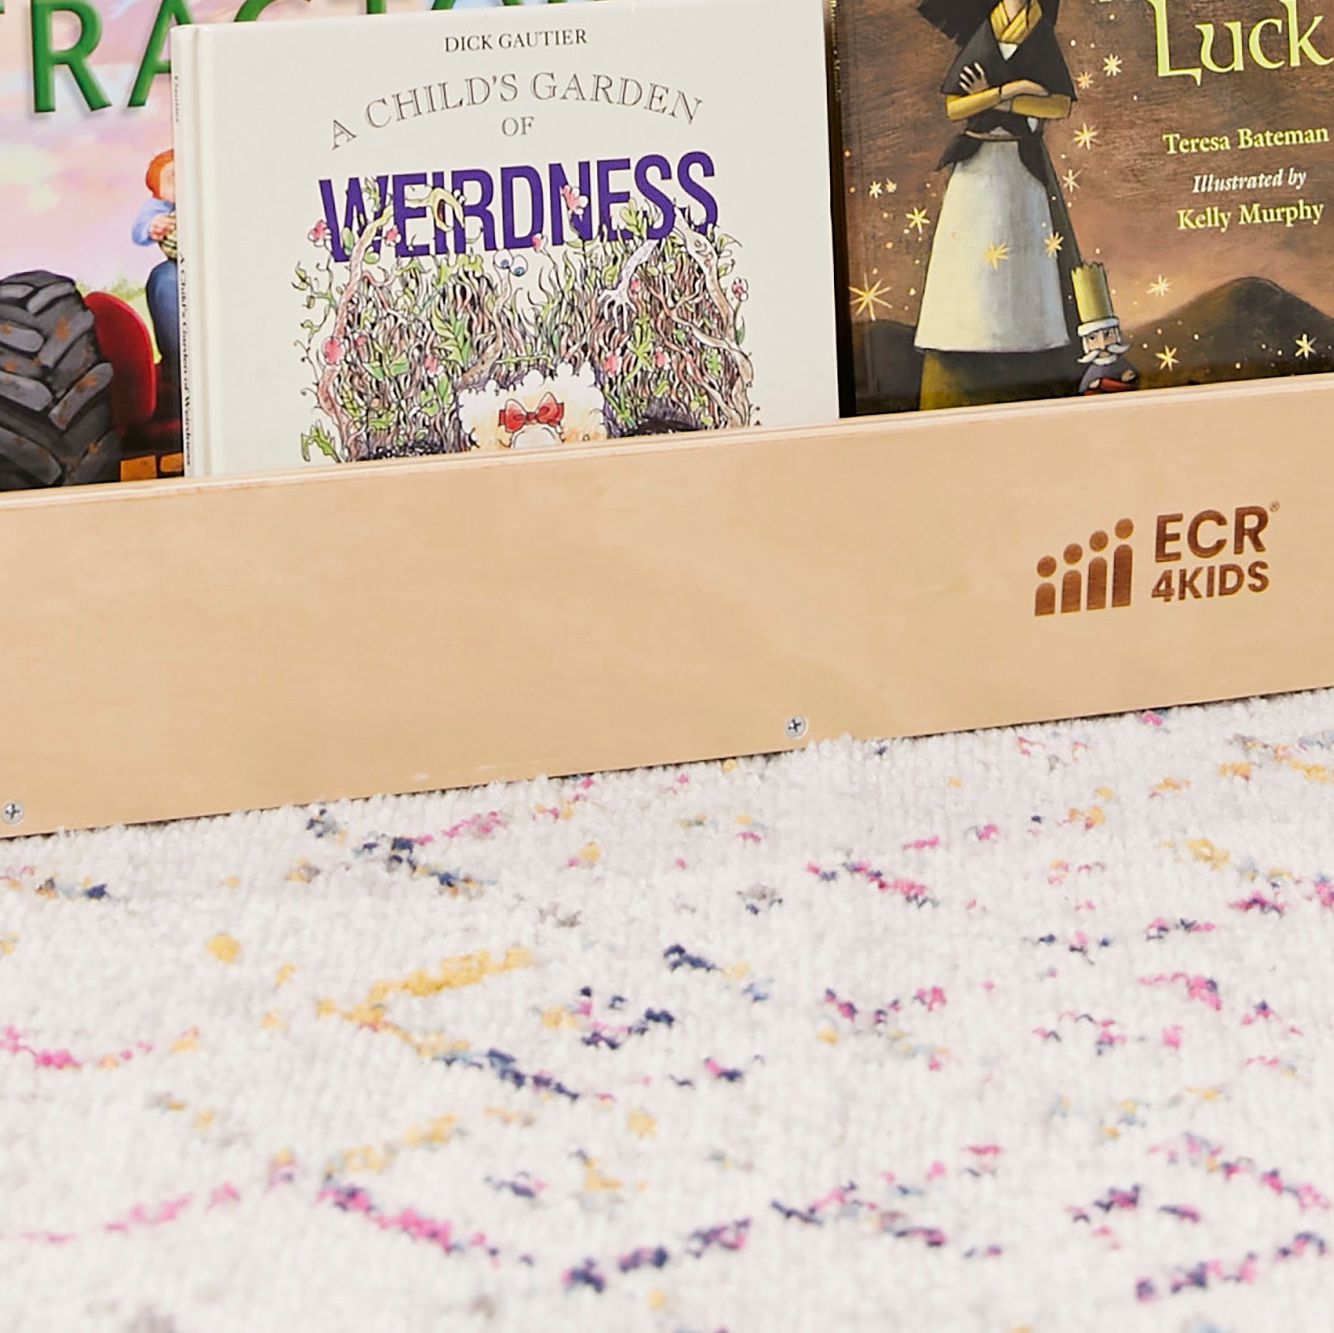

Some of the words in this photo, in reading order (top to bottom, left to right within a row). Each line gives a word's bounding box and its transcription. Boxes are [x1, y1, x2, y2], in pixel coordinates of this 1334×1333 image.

[444, 34, 493, 52] DICK
[499, 29, 587, 50] GAUTIER
[331, 118, 357, 151] A
[364, 73, 519, 129] CHILD'S
[530, 71, 703, 126] GARDEN
[501, 116, 535, 137] OF
[1163, 132, 1231, 154] Teresa
[1237, 127, 1330, 149] Bateman
[1192, 167, 1284, 193] Illustrated
[1287, 167, 1307, 190] by
[318, 151, 719, 263] WEIRDNESS
[1177, 206, 1231, 232] Kelly
[1238, 199, 1324, 227] Murphy
[1151, 560, 1270, 602] 4KIDS
